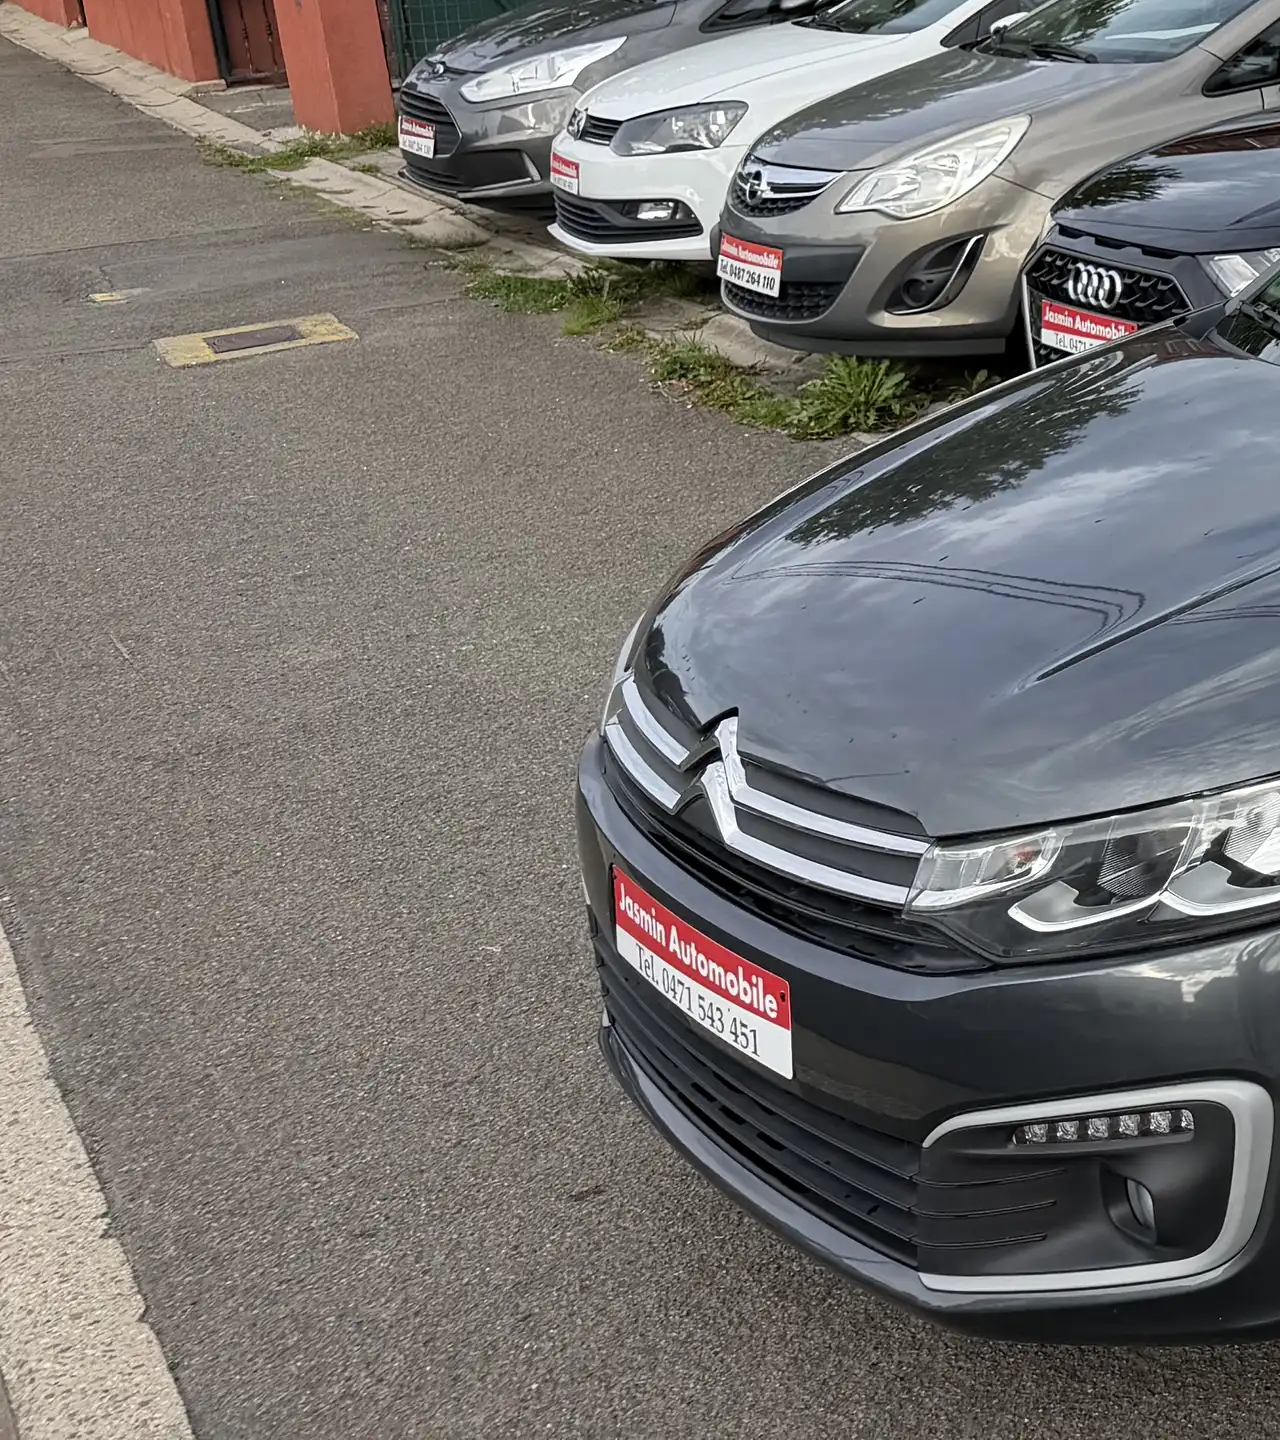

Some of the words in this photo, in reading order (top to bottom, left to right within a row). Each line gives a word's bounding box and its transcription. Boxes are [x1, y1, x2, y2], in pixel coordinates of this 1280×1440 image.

[739, 245, 779, 268] Automobile
[729, 263, 745, 281] 0487
[745, 269, 761, 286] 264
[762, 275, 776, 291] 110
[1044, 306, 1073, 327] Jasmin
[619, 882, 666, 947] Jasmin
[669, 925, 778, 1019] Automobile
[635, 943, 660, 985] Tel.
[662, 967, 693, 1012] 0471
[698, 994, 725, 1034] 543
[729, 1016, 761, 1057] 451
